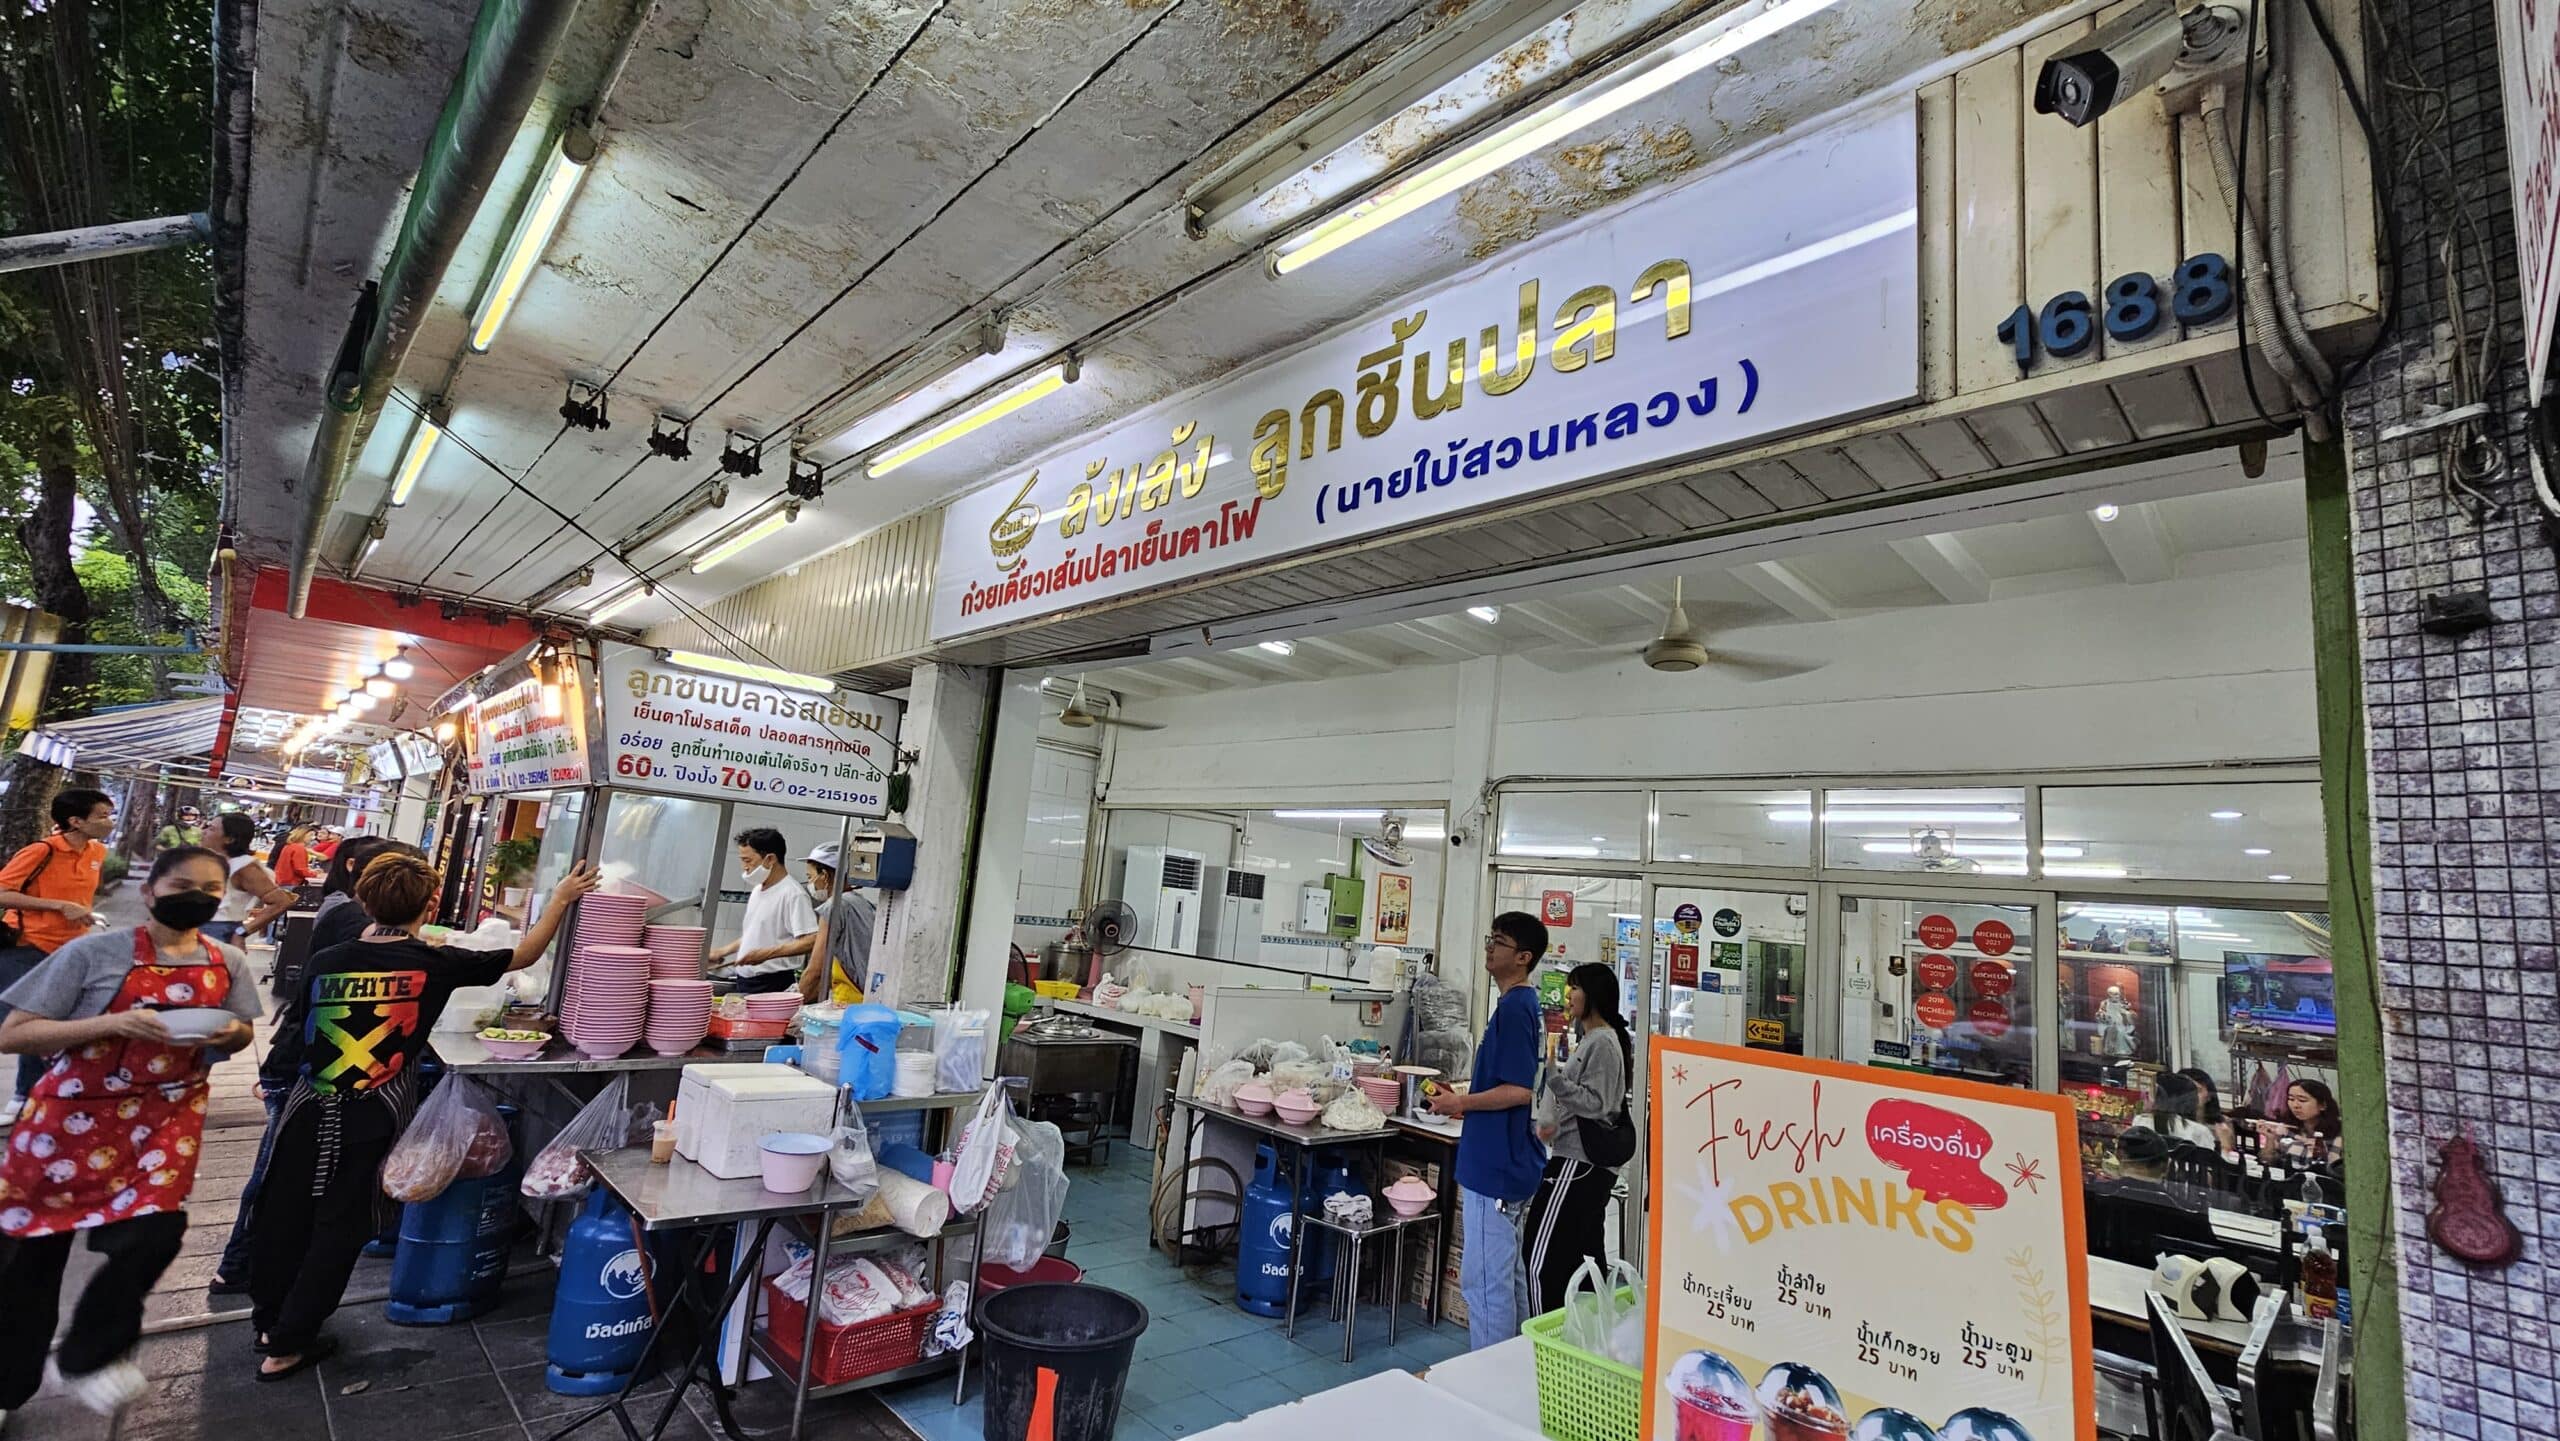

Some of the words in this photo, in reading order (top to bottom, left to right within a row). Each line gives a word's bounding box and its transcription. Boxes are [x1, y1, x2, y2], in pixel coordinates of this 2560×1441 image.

[1997, 253, 2233, 369] 1688
[1249, 257, 1693, 500] ลูกชิ้นปลา
[961, 496, 1263, 617] ก๋วยเตี๋ยวเส้นปลาเย็นตาโฟ
[620, 730, 663, 750] อร่อย
[788, 785, 878, 805] 02-2151905
[1921, 925, 1954, 934] MICHELIN
[1975, 931, 2011, 940] MICHELIN
[1722, 957, 1741, 966] Food
[1723, 950, 1741, 958] Grab
[1921, 962, 1954, 972] MICHELIN
[320, 976, 412, 998] WHITE
[1973, 972, 2009, 980] MICHELIN
[1917, 1006, 1955, 1016] MICHELIN
[1686, 1079, 1845, 1187] Fresh
[1873, 1119, 1982, 1160] เครื่องดื่ม
[1728, 1176, 1977, 1253] DRINKS
[1707, 1300, 1726, 1319] 25
[1731, 1314, 1756, 1333] บาท
[1778, 1286, 1798, 1306] 25
[1805, 1301, 1832, 1320] บาท
[1961, 1321, 2033, 1364] น้ำมะตูม
[1858, 1344, 1880, 1365] 25
[1889, 1361, 1918, 1382] บาท
[1963, 1346, 1987, 1369] 25
[1997, 1363, 2024, 1381] บาท
